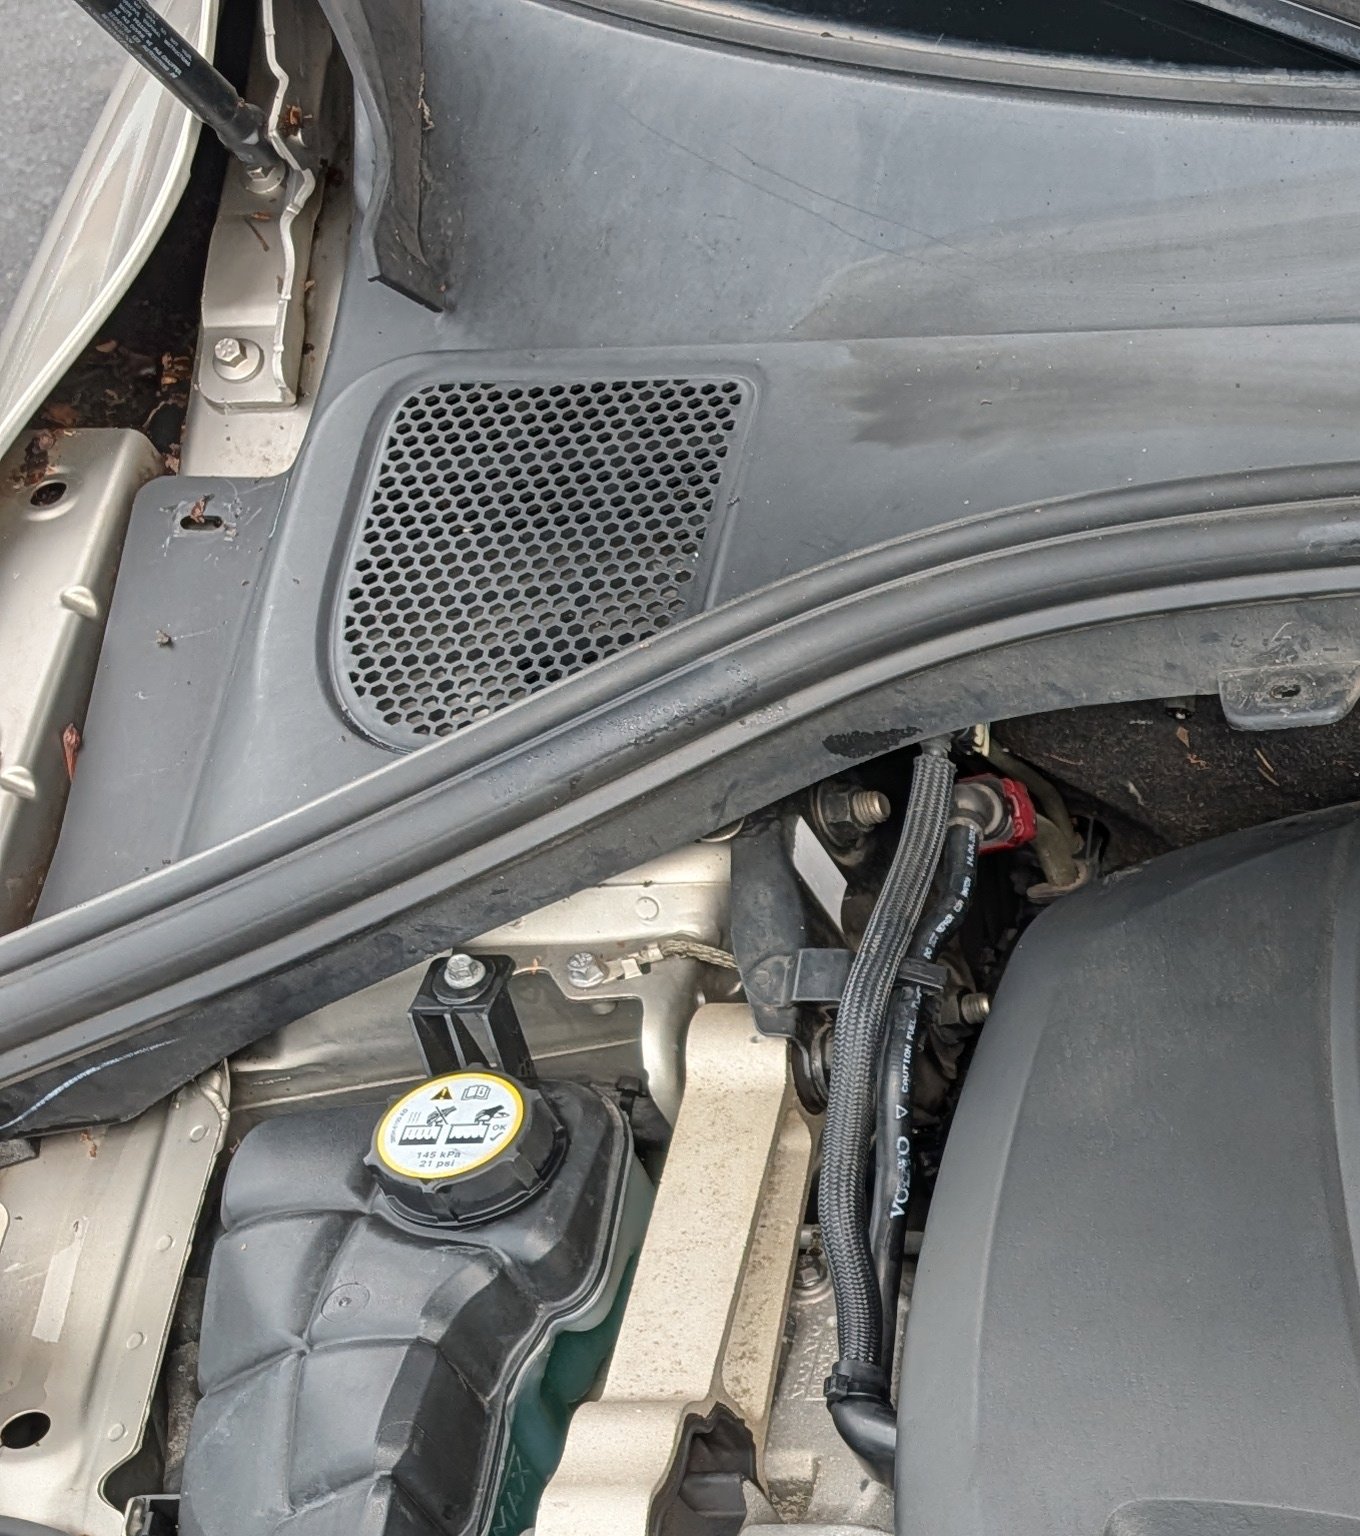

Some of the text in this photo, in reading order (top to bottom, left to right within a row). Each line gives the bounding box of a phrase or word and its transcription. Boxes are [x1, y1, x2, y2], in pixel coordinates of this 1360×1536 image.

[901, 1044, 913, 1094] CAUTION
[492, 1124, 507, 1132] OK
[416, 1150, 462, 1160] 145 kPa
[418, 1159, 456, 1168] 21 psi
